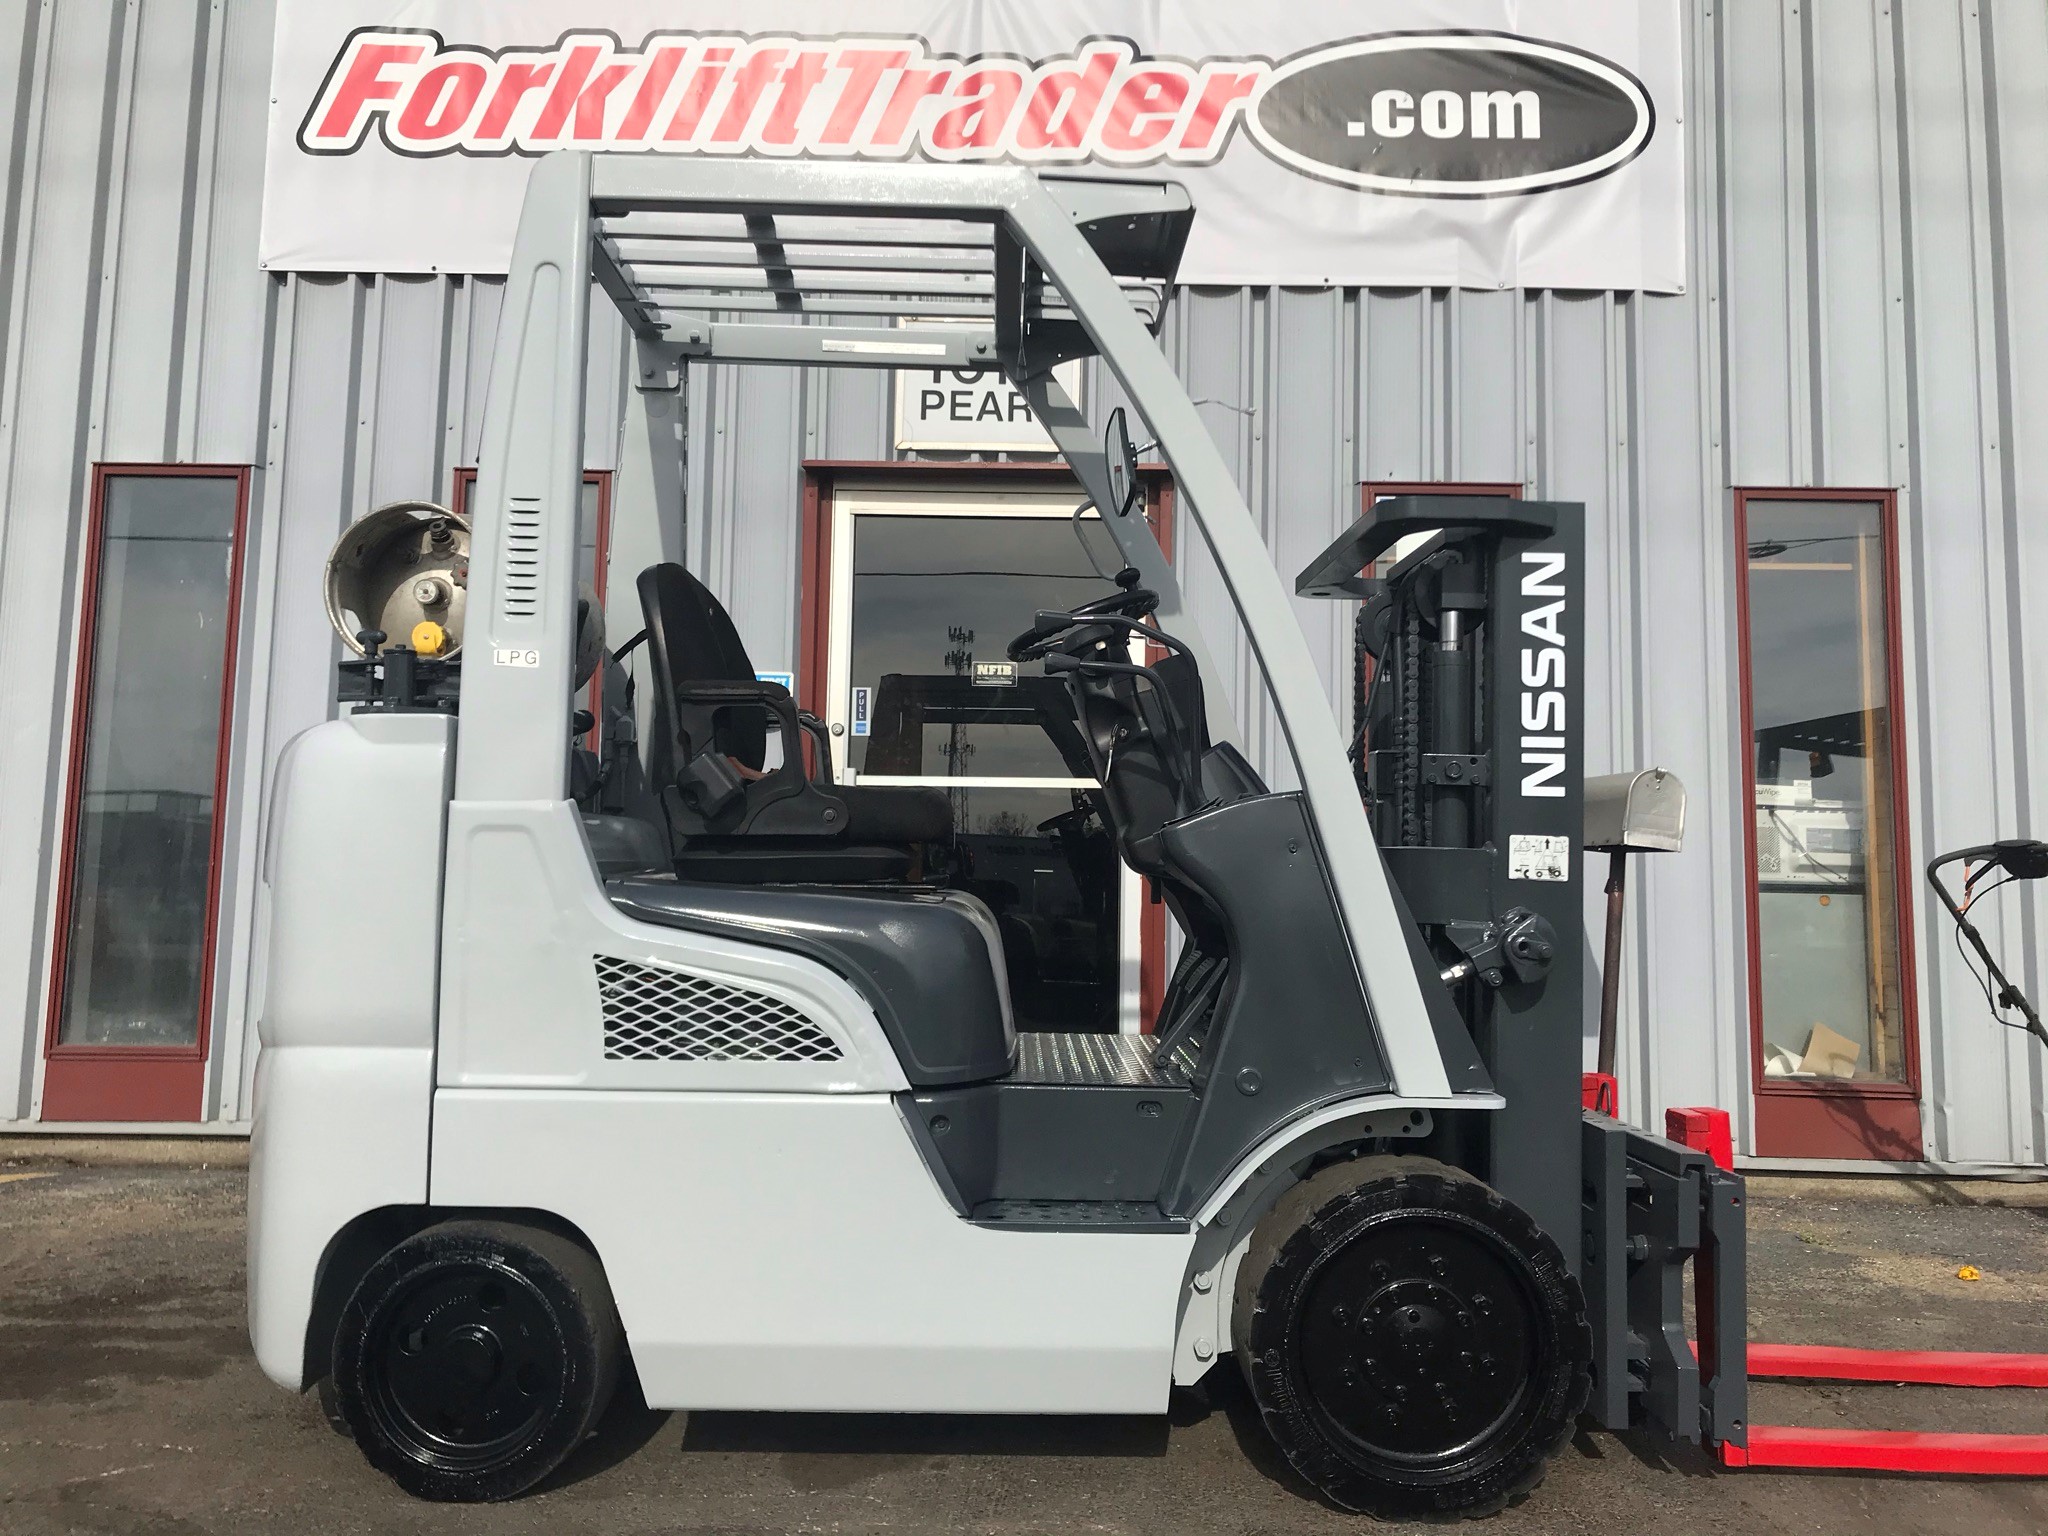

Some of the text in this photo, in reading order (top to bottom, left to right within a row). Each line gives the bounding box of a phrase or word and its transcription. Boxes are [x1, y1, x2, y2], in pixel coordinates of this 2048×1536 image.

[496, 650, 537, 665] LPG
[977, 664, 1012, 675] NFIB
[1521, 552, 1566, 798] NISSAN
